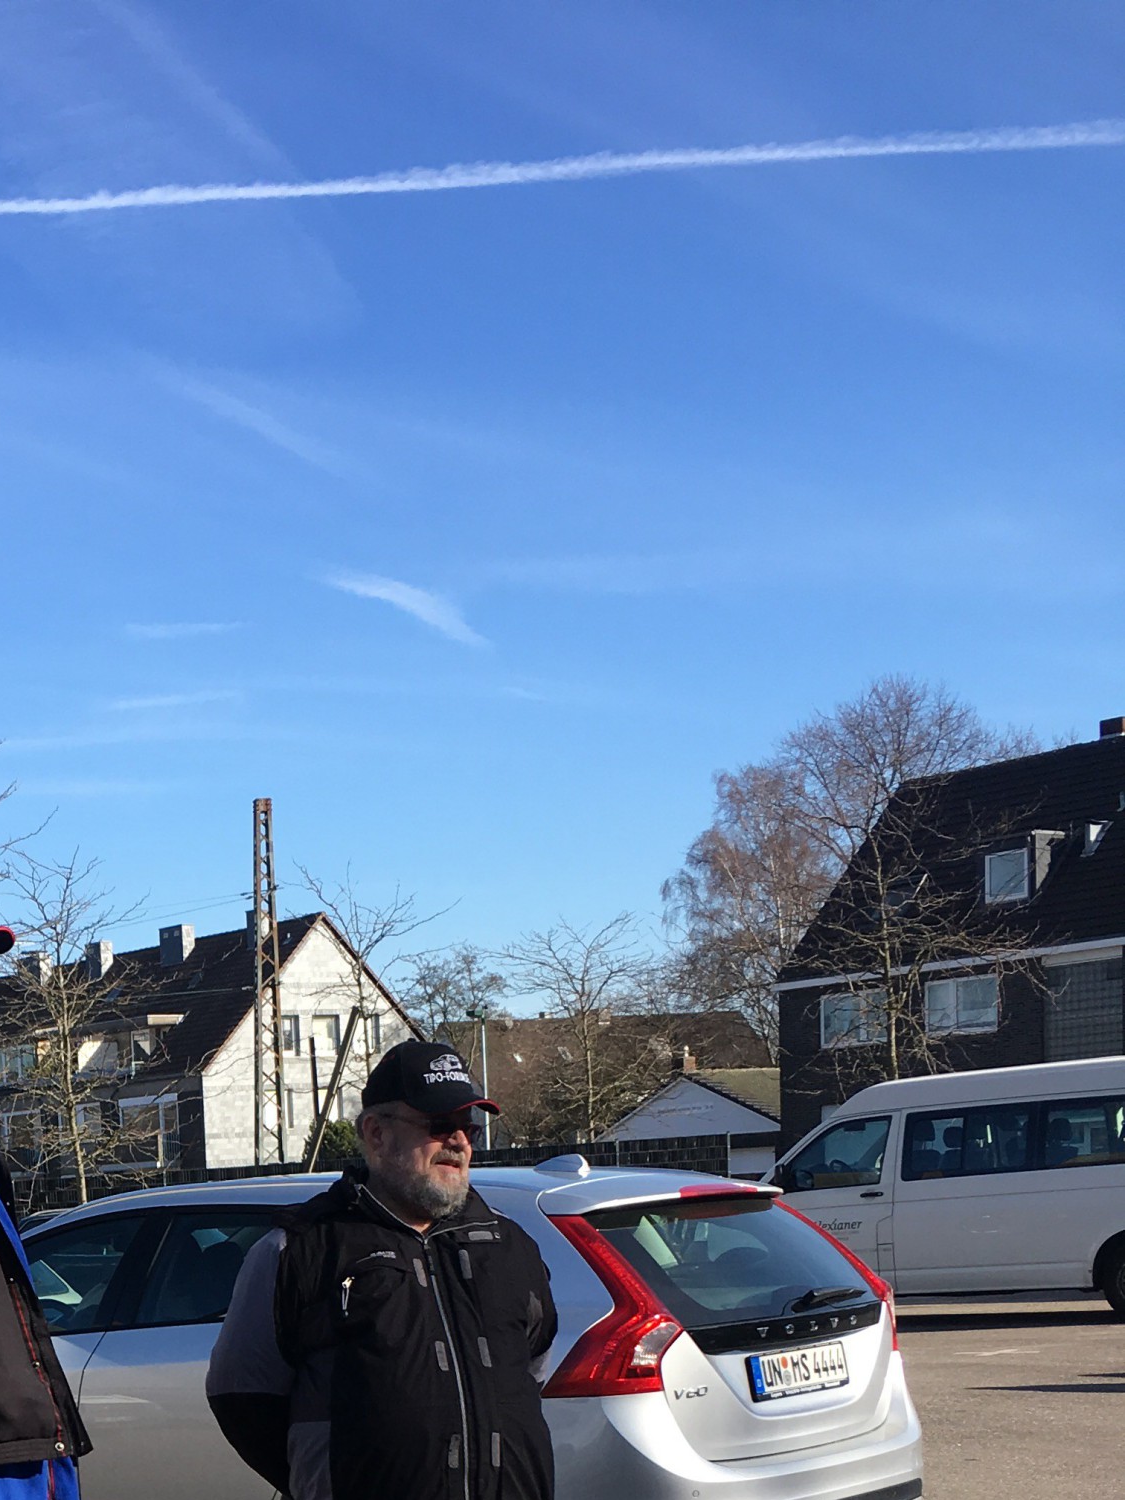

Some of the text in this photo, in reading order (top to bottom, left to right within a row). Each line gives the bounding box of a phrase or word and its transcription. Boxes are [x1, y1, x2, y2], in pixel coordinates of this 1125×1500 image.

[815, 1218, 862, 1231] lexianer
[757, 1314, 858, 1338] VOLVO
[761, 1348, 845, 1388] UN MS 4444
